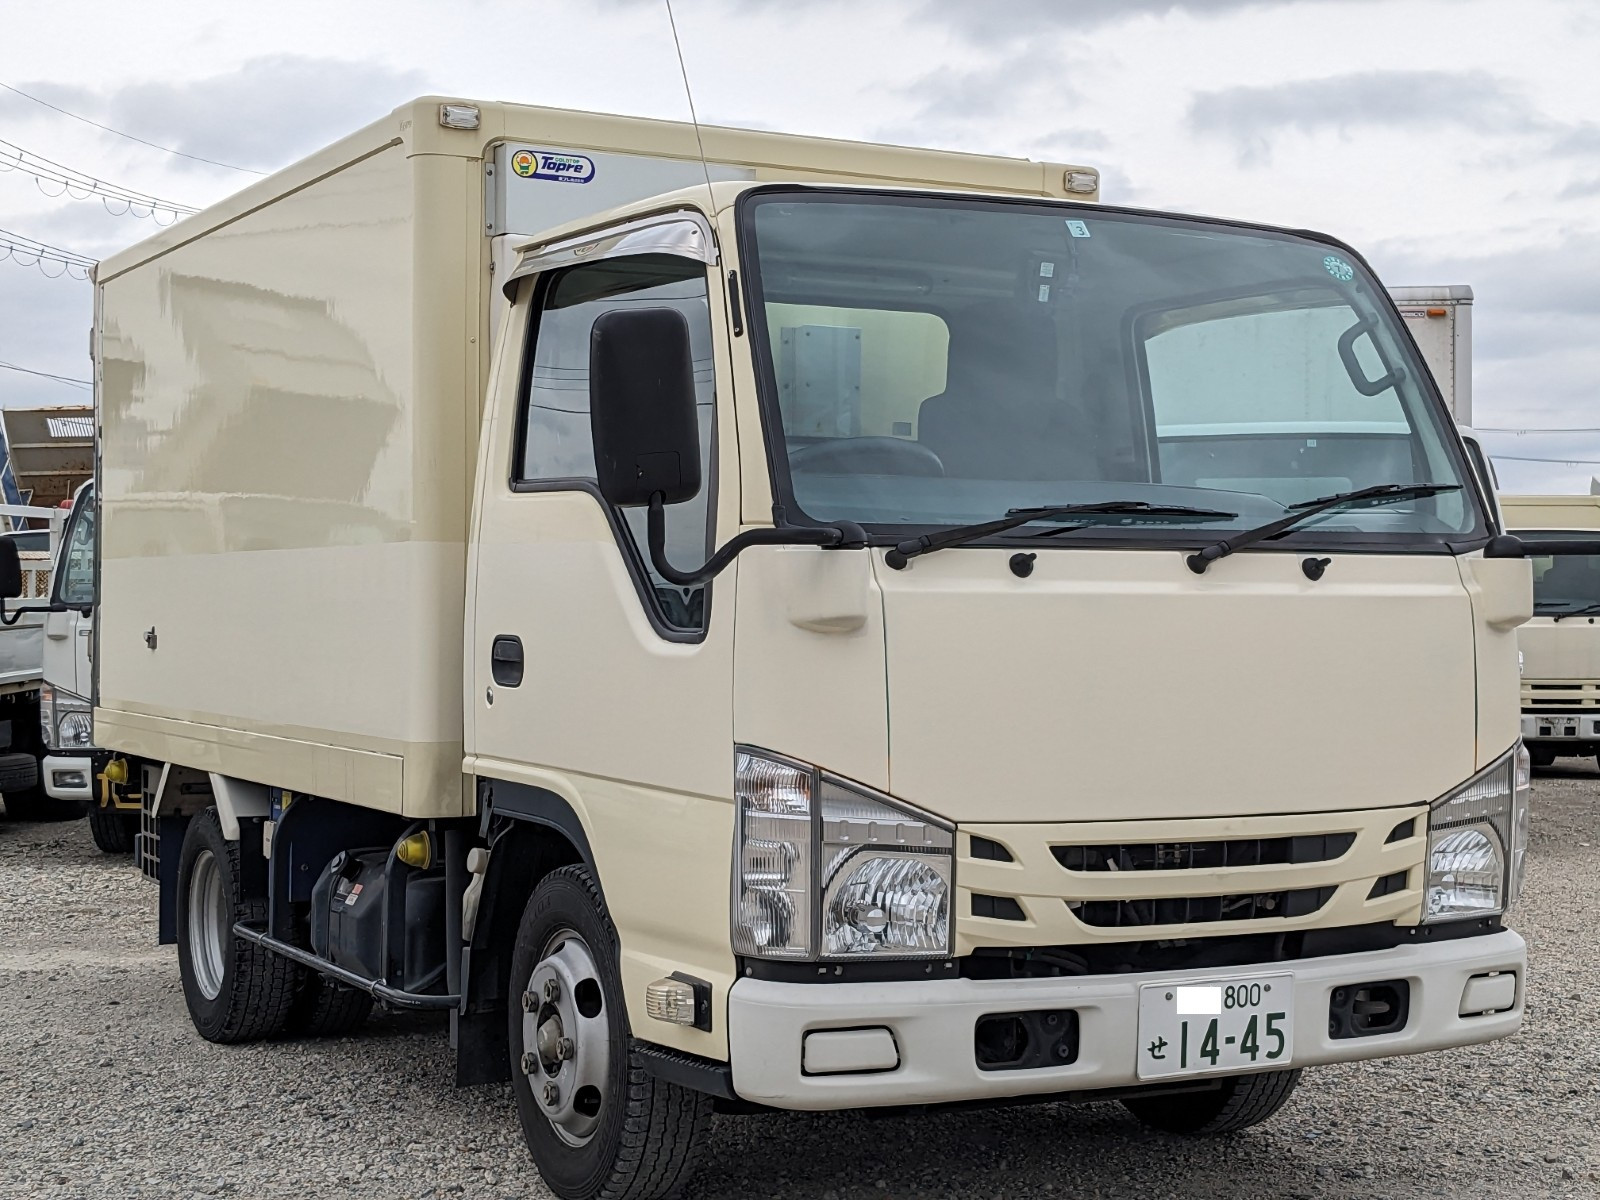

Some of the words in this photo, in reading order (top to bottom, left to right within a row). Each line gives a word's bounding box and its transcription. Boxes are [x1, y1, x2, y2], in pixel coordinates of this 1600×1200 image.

[541, 156, 584, 173] Topre
[1075, 226, 1085, 236] 3
[1224, 983, 1261, 1009] 800
[1147, 1036, 1168, 1060] せ
[1180, 1011, 1286, 1069] 14-45
